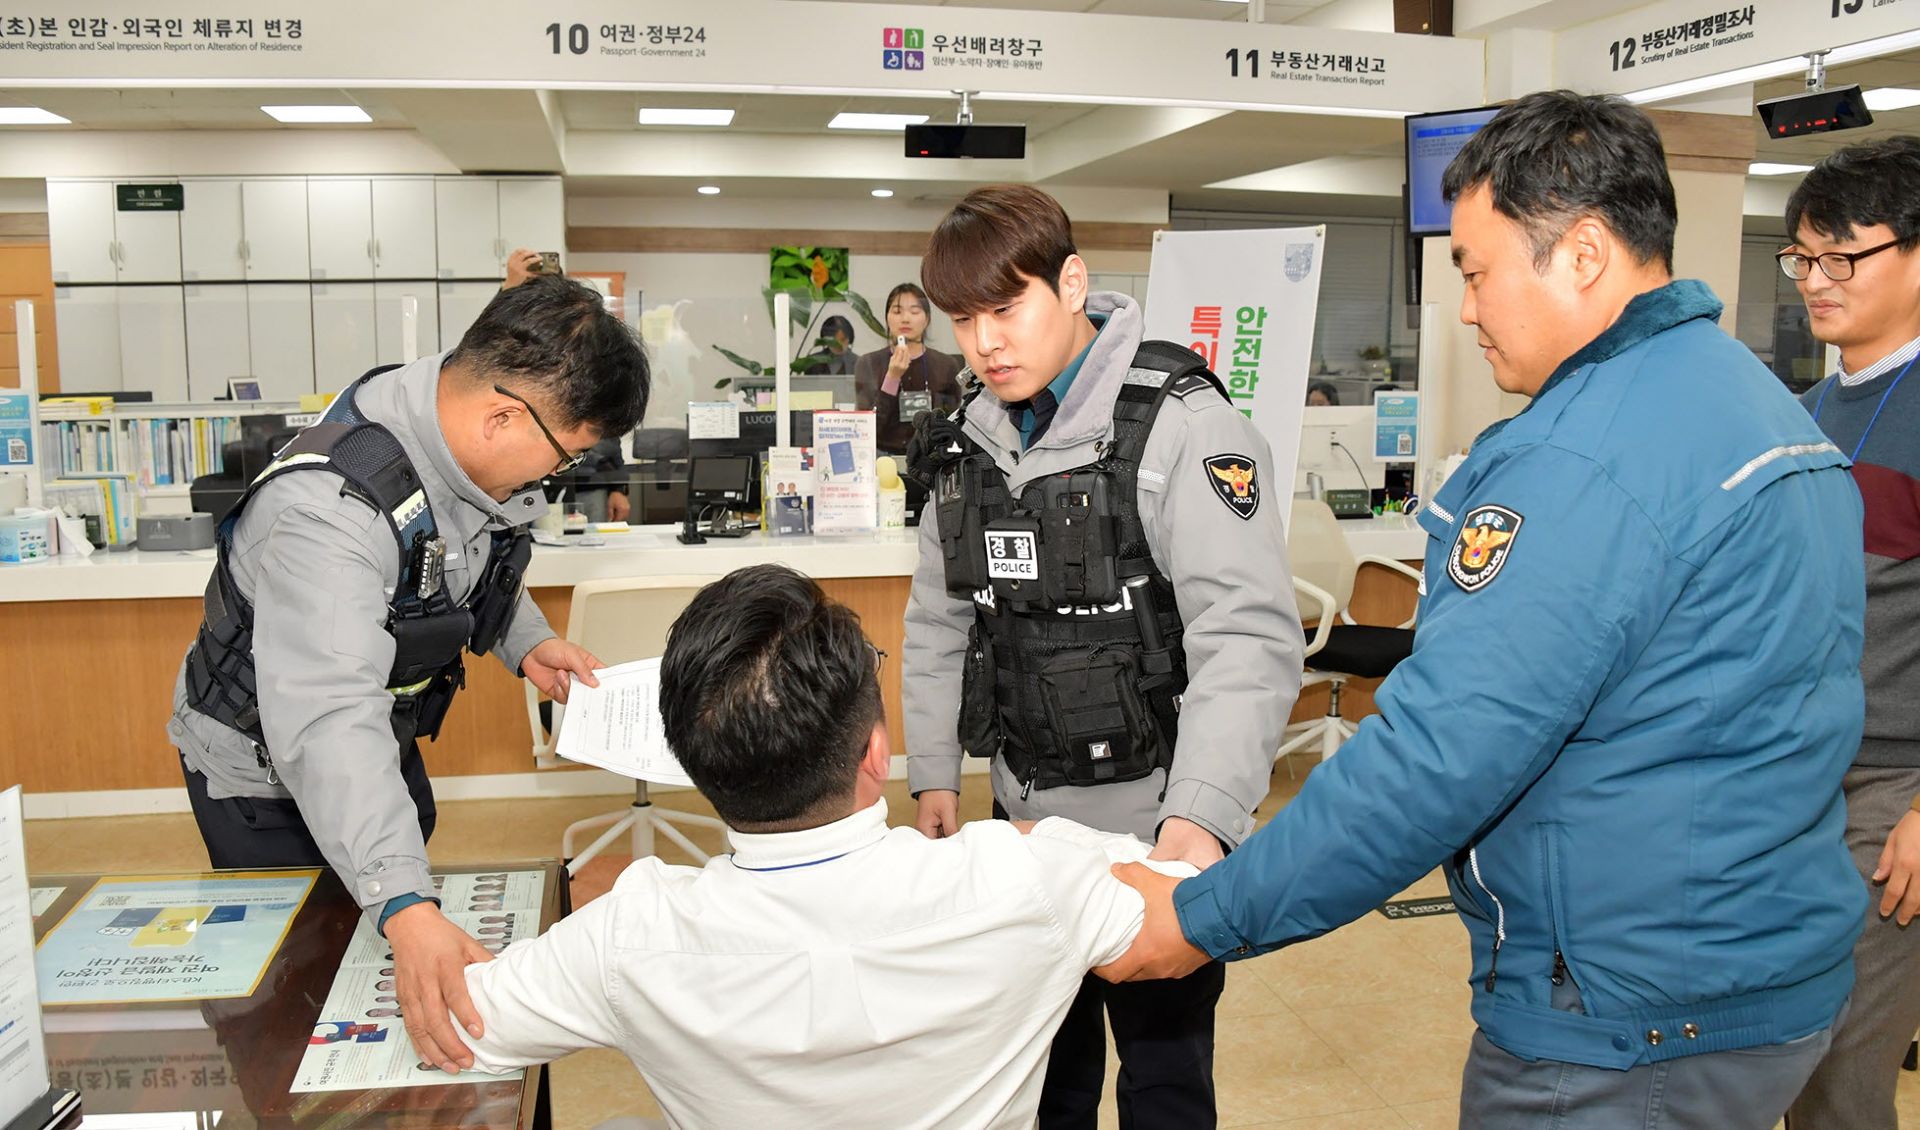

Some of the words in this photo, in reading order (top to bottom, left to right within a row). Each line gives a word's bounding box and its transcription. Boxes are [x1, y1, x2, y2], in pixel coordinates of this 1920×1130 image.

[68, 17, 182, 38] 인감·외국인
[193, 18, 253, 38] 체류지
[264, 19, 302, 39] 변경
[546, 23, 589, 55] 10
[600, 24, 706, 44] 여권·정부24
[1641, 5, 1755, 52] 부동산거래정밀조사
[27, 41, 77, 51] Registration
[79, 42, 95, 50] and
[97, 41, 115, 50] Seal
[117, 42, 161, 52] Impression
[163, 42, 192, 52] Report
[207, 42, 247, 51] Alteration
[249, 42, 258, 51] of
[260, 43, 302, 51] Residence
[695, 49, 706, 57] 24
[932, 34, 1043, 57] 우선배려창구
[1609, 37, 1636, 72] 12
[1641, 53, 1665, 65] Scrutiny
[1666, 49, 1674, 58] of
[1675, 46, 1689, 56] Real
[1690, 41, 1710, 53] Estate
[1712, 31, 1754, 47] Transactions
[1226, 48, 1259, 78] 11
[1270, 51, 1386, 73] 부동산거래신고
[1270, 70, 1287, 79] Real
[1289, 72, 1313, 82] Estate
[1315, 74, 1358, 84] Transaction
[1359, 76, 1385, 86] Report
[1229, 306, 1267, 400] 안전한
[993, 562, 1032, 574] POLICE
[1480, 549, 1504, 580] POLICE
[87, 954, 206, 967] 가능해집니다!
[120, 964, 175, 976] 재발급
[181, 963, 220, 974] 여권
[56, 967, 113, 979] 신청이
